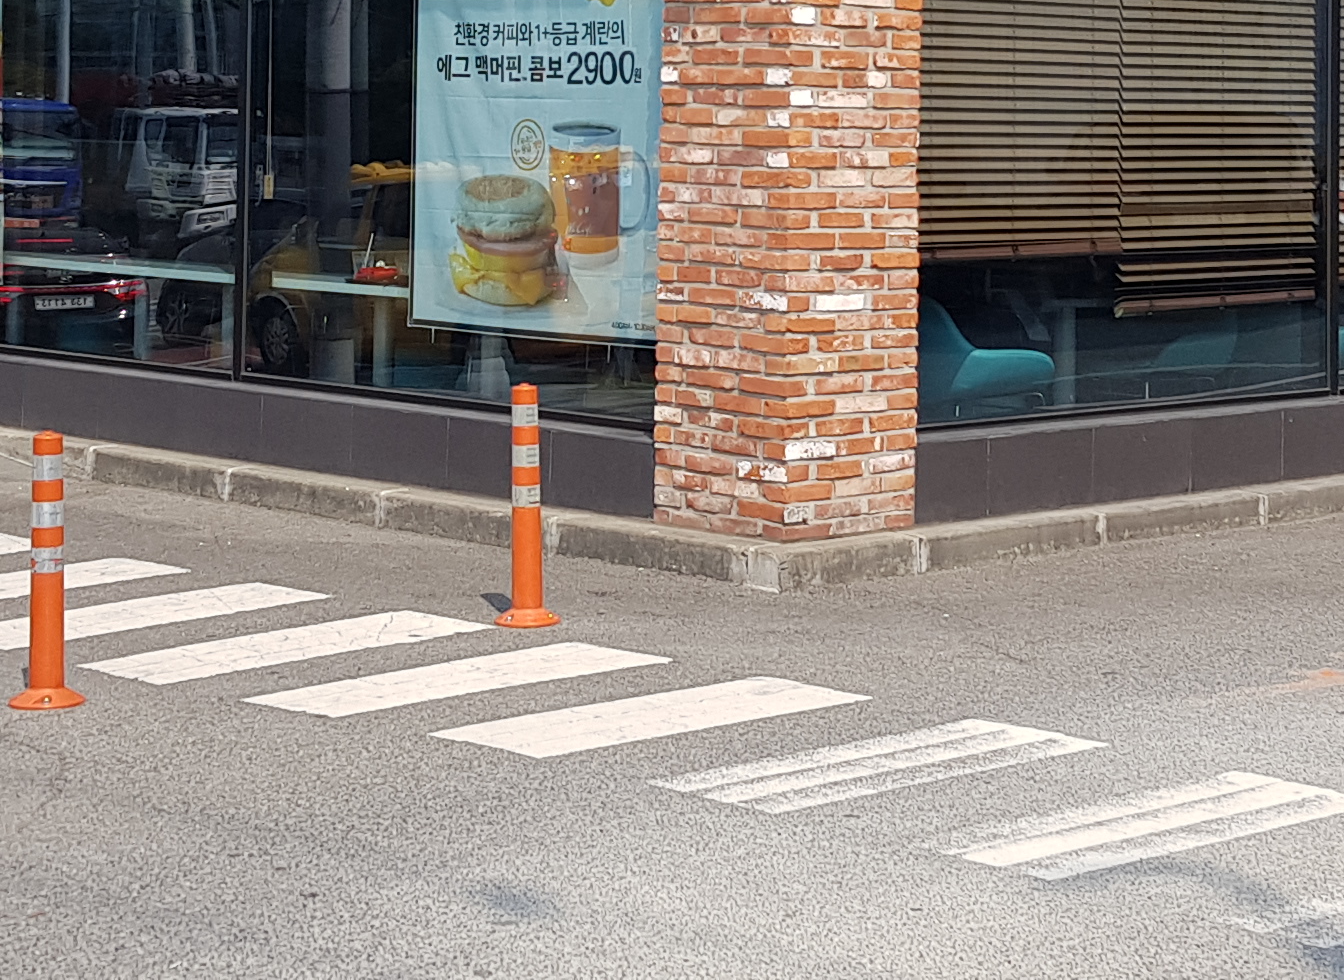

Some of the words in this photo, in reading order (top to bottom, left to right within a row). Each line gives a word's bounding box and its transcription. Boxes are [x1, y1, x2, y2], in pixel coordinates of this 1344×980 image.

[454, 22, 490, 46] 친환경
[493, 22, 533, 47] 커피와
[535, 22, 579, 47] 1+등급
[581, 20, 625, 46] 계란의
[437, 54, 471, 81] 에그
[528, 55, 564, 82] 콤보
